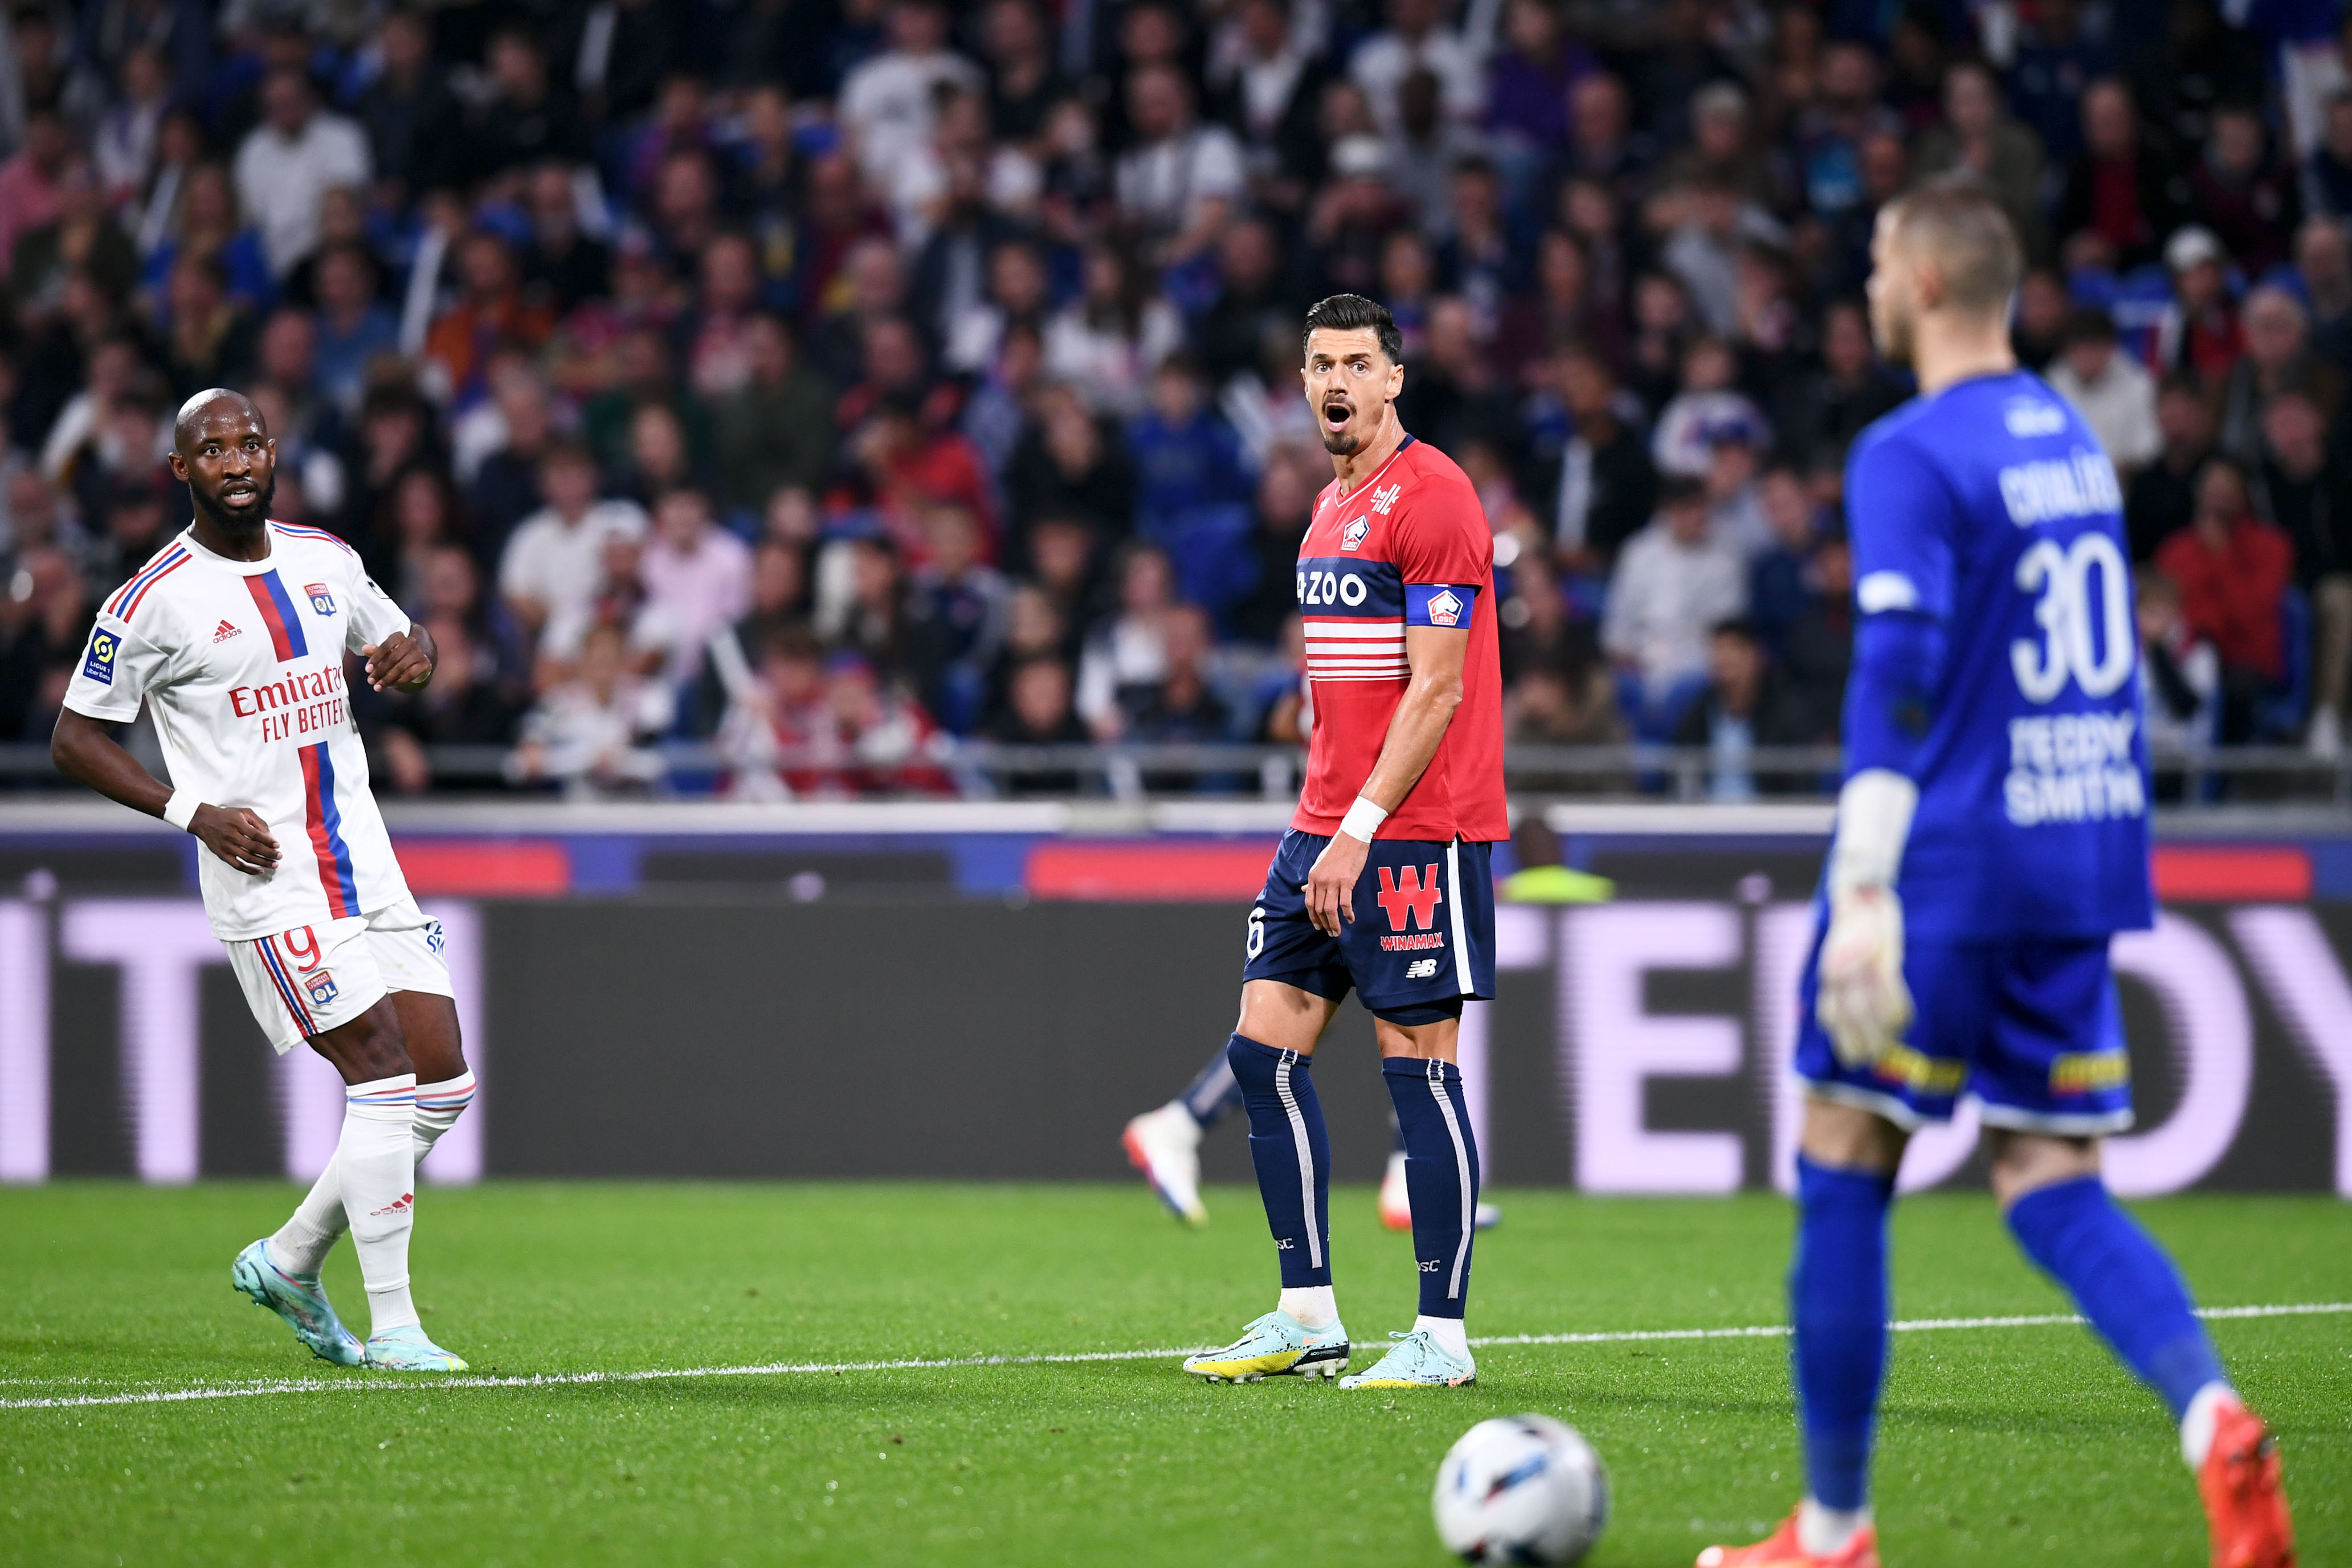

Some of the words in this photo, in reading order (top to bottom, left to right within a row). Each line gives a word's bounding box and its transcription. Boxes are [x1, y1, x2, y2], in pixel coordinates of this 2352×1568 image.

[1434, 615, 1454, 623] LOSC
[2009, 533, 2135, 704] 30
[213, 628, 242, 644] adidas
[86, 667, 99, 676] Uber
[99, 672, 111, 681] Eats
[90, 661, 107, 672] LIGUE
[262, 712, 289, 743] FLY
[297, 698, 345, 733] BETTER
[1377, 863, 1443, 931] W
[1246, 907, 1266, 959] 6
[1380, 932, 1445, 951] WINAMAX
[284, 925, 321, 974] 9
